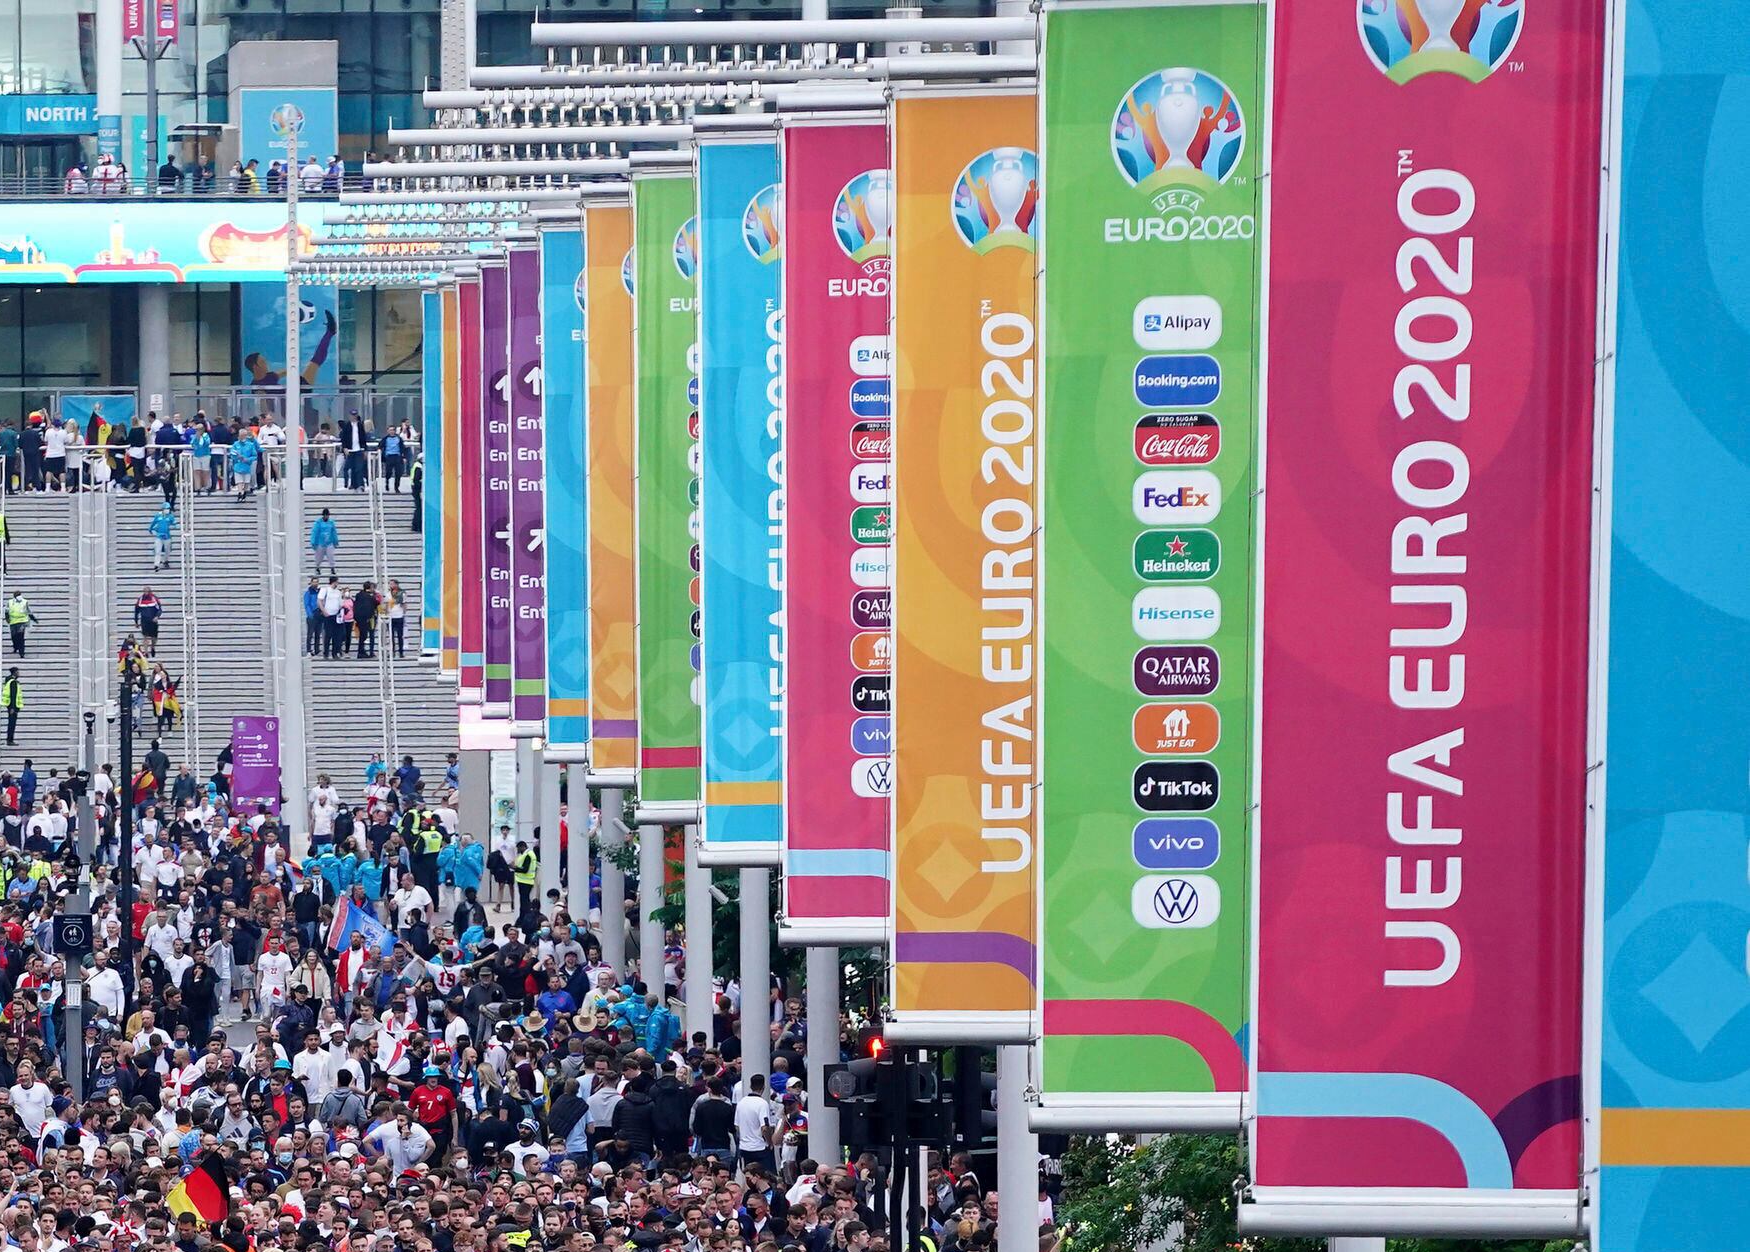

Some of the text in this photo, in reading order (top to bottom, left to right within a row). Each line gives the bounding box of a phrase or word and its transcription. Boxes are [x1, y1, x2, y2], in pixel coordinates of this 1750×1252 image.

[26, 107, 86, 122] NORTH
[1154, 190, 1200, 212] UEFA
[1104, 215, 1255, 243] EURO2020
[828, 278, 890, 297] EURO
[1393, 167, 1476, 423] 2020
[1164, 314, 1211, 331] Alipay
[1137, 374, 1217, 389] Booking.com
[980, 311, 1034, 488] 2020
[1156, 415, 1175, 423] ZERO
[1143, 487, 1210, 508] FedEx
[1143, 559, 1210, 573] Heineken
[1387, 439, 1471, 709] EURO
[981, 497, 1033, 683] EURO
[1138, 607, 1215, 620] Hisense
[1142, 656, 1210, 678] QATAR
[1158, 673, 1211, 686] AIRWAYS
[1156, 738, 1196, 749] JUST EAT
[981, 695, 1033, 874] UEFA
[1157, 780, 1213, 796] TikTok
[1148, 833, 1204, 850] vivo
[1383, 726, 1466, 989] UEFA
[427, 1100, 434, 1110] 7
